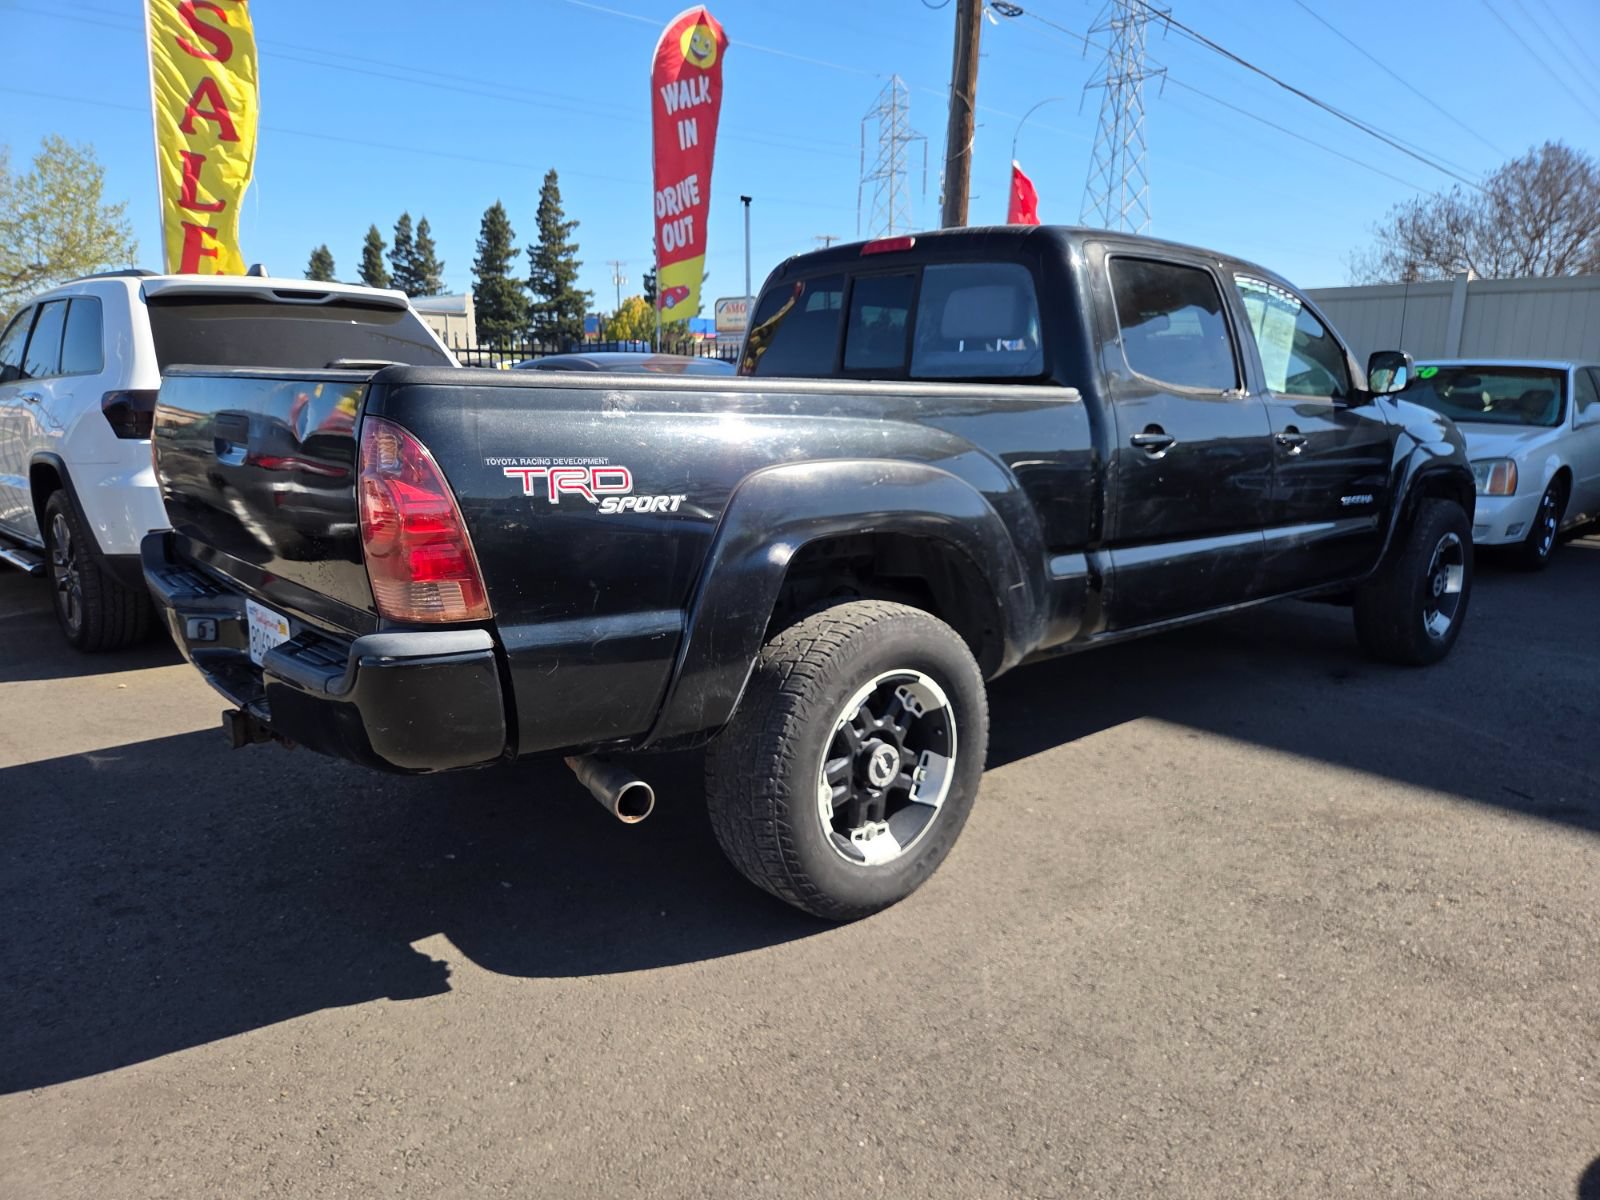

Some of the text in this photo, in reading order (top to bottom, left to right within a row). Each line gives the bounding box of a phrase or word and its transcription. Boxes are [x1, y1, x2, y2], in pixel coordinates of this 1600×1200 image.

[661, 75, 712, 116] WALK
[176, 0, 241, 275] SALE
[677, 117, 698, 151] IN
[656, 174, 700, 218] DRIVE
[662, 217, 694, 253] OUT
[486, 458, 518, 466] TOYOTA
[520, 458, 551, 466] RACING
[503, 466, 633, 504] TRD
[598, 495, 686, 514] SPORT
